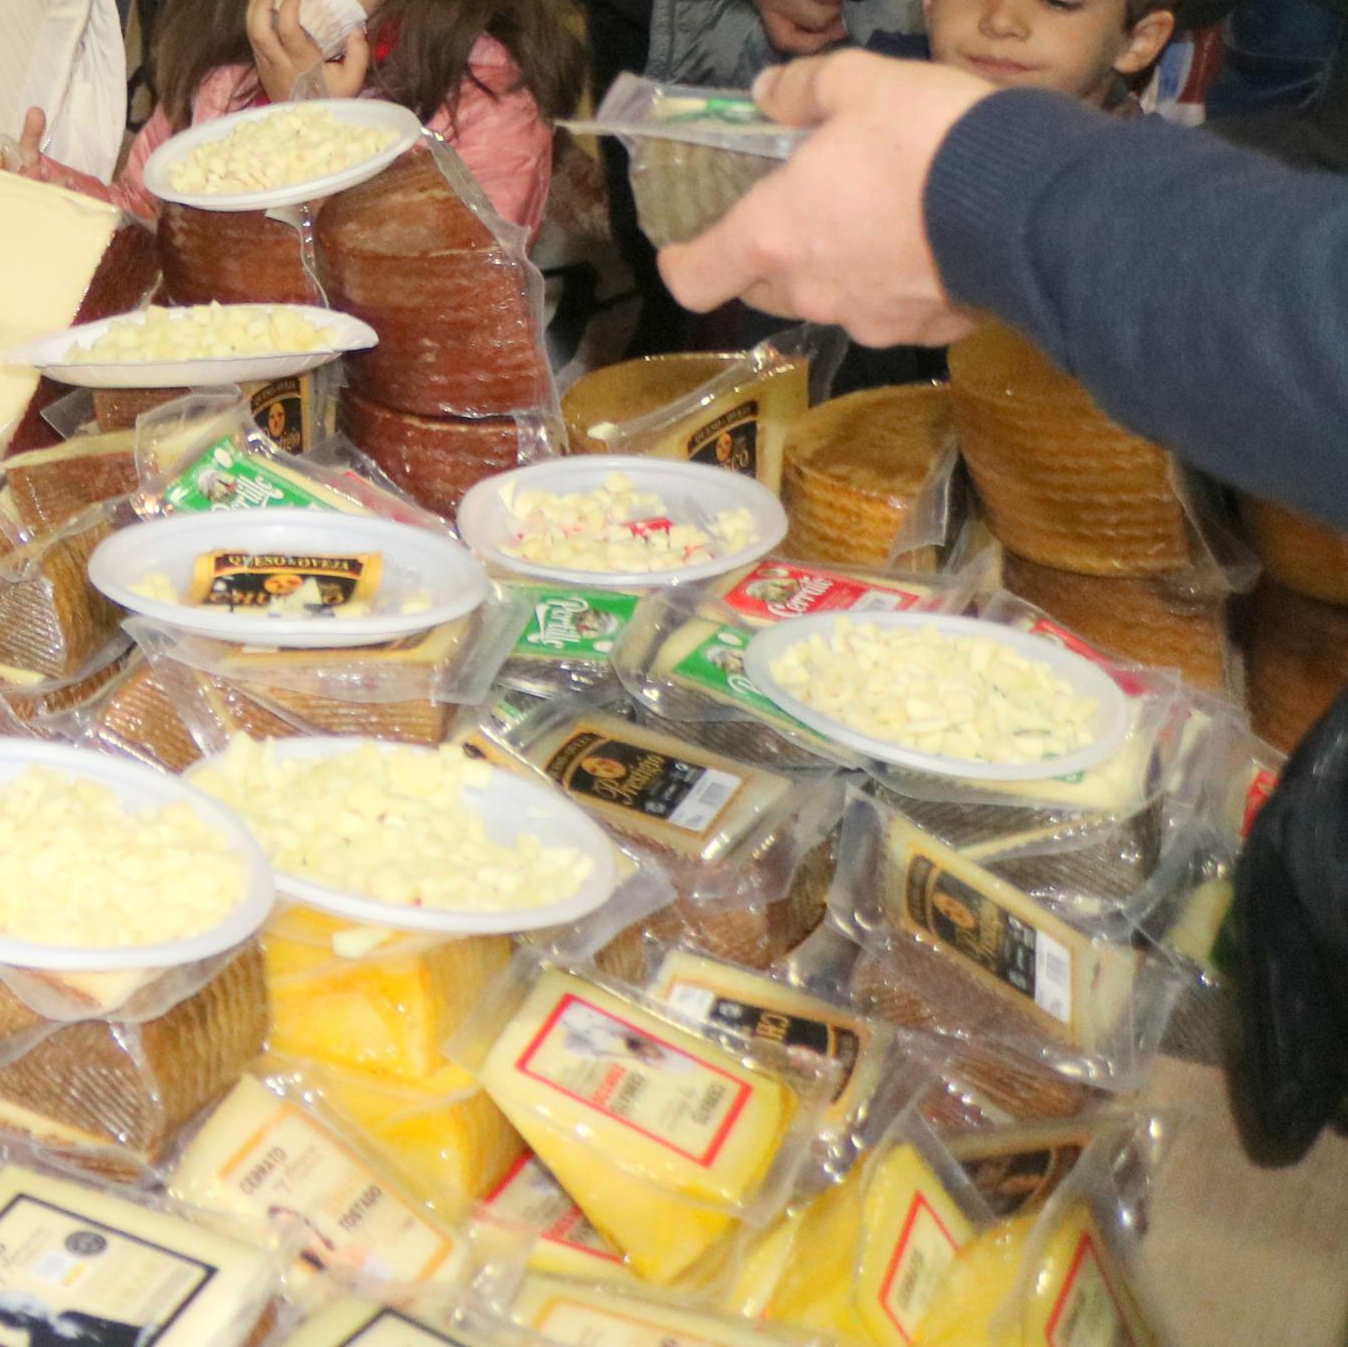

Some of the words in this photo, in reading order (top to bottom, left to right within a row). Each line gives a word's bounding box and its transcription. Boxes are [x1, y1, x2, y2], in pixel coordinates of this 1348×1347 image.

[297, 557, 350, 571] OVEJA
[239, 1146, 289, 1196] CERRATO
[338, 1184, 383, 1232] TOSTADO
